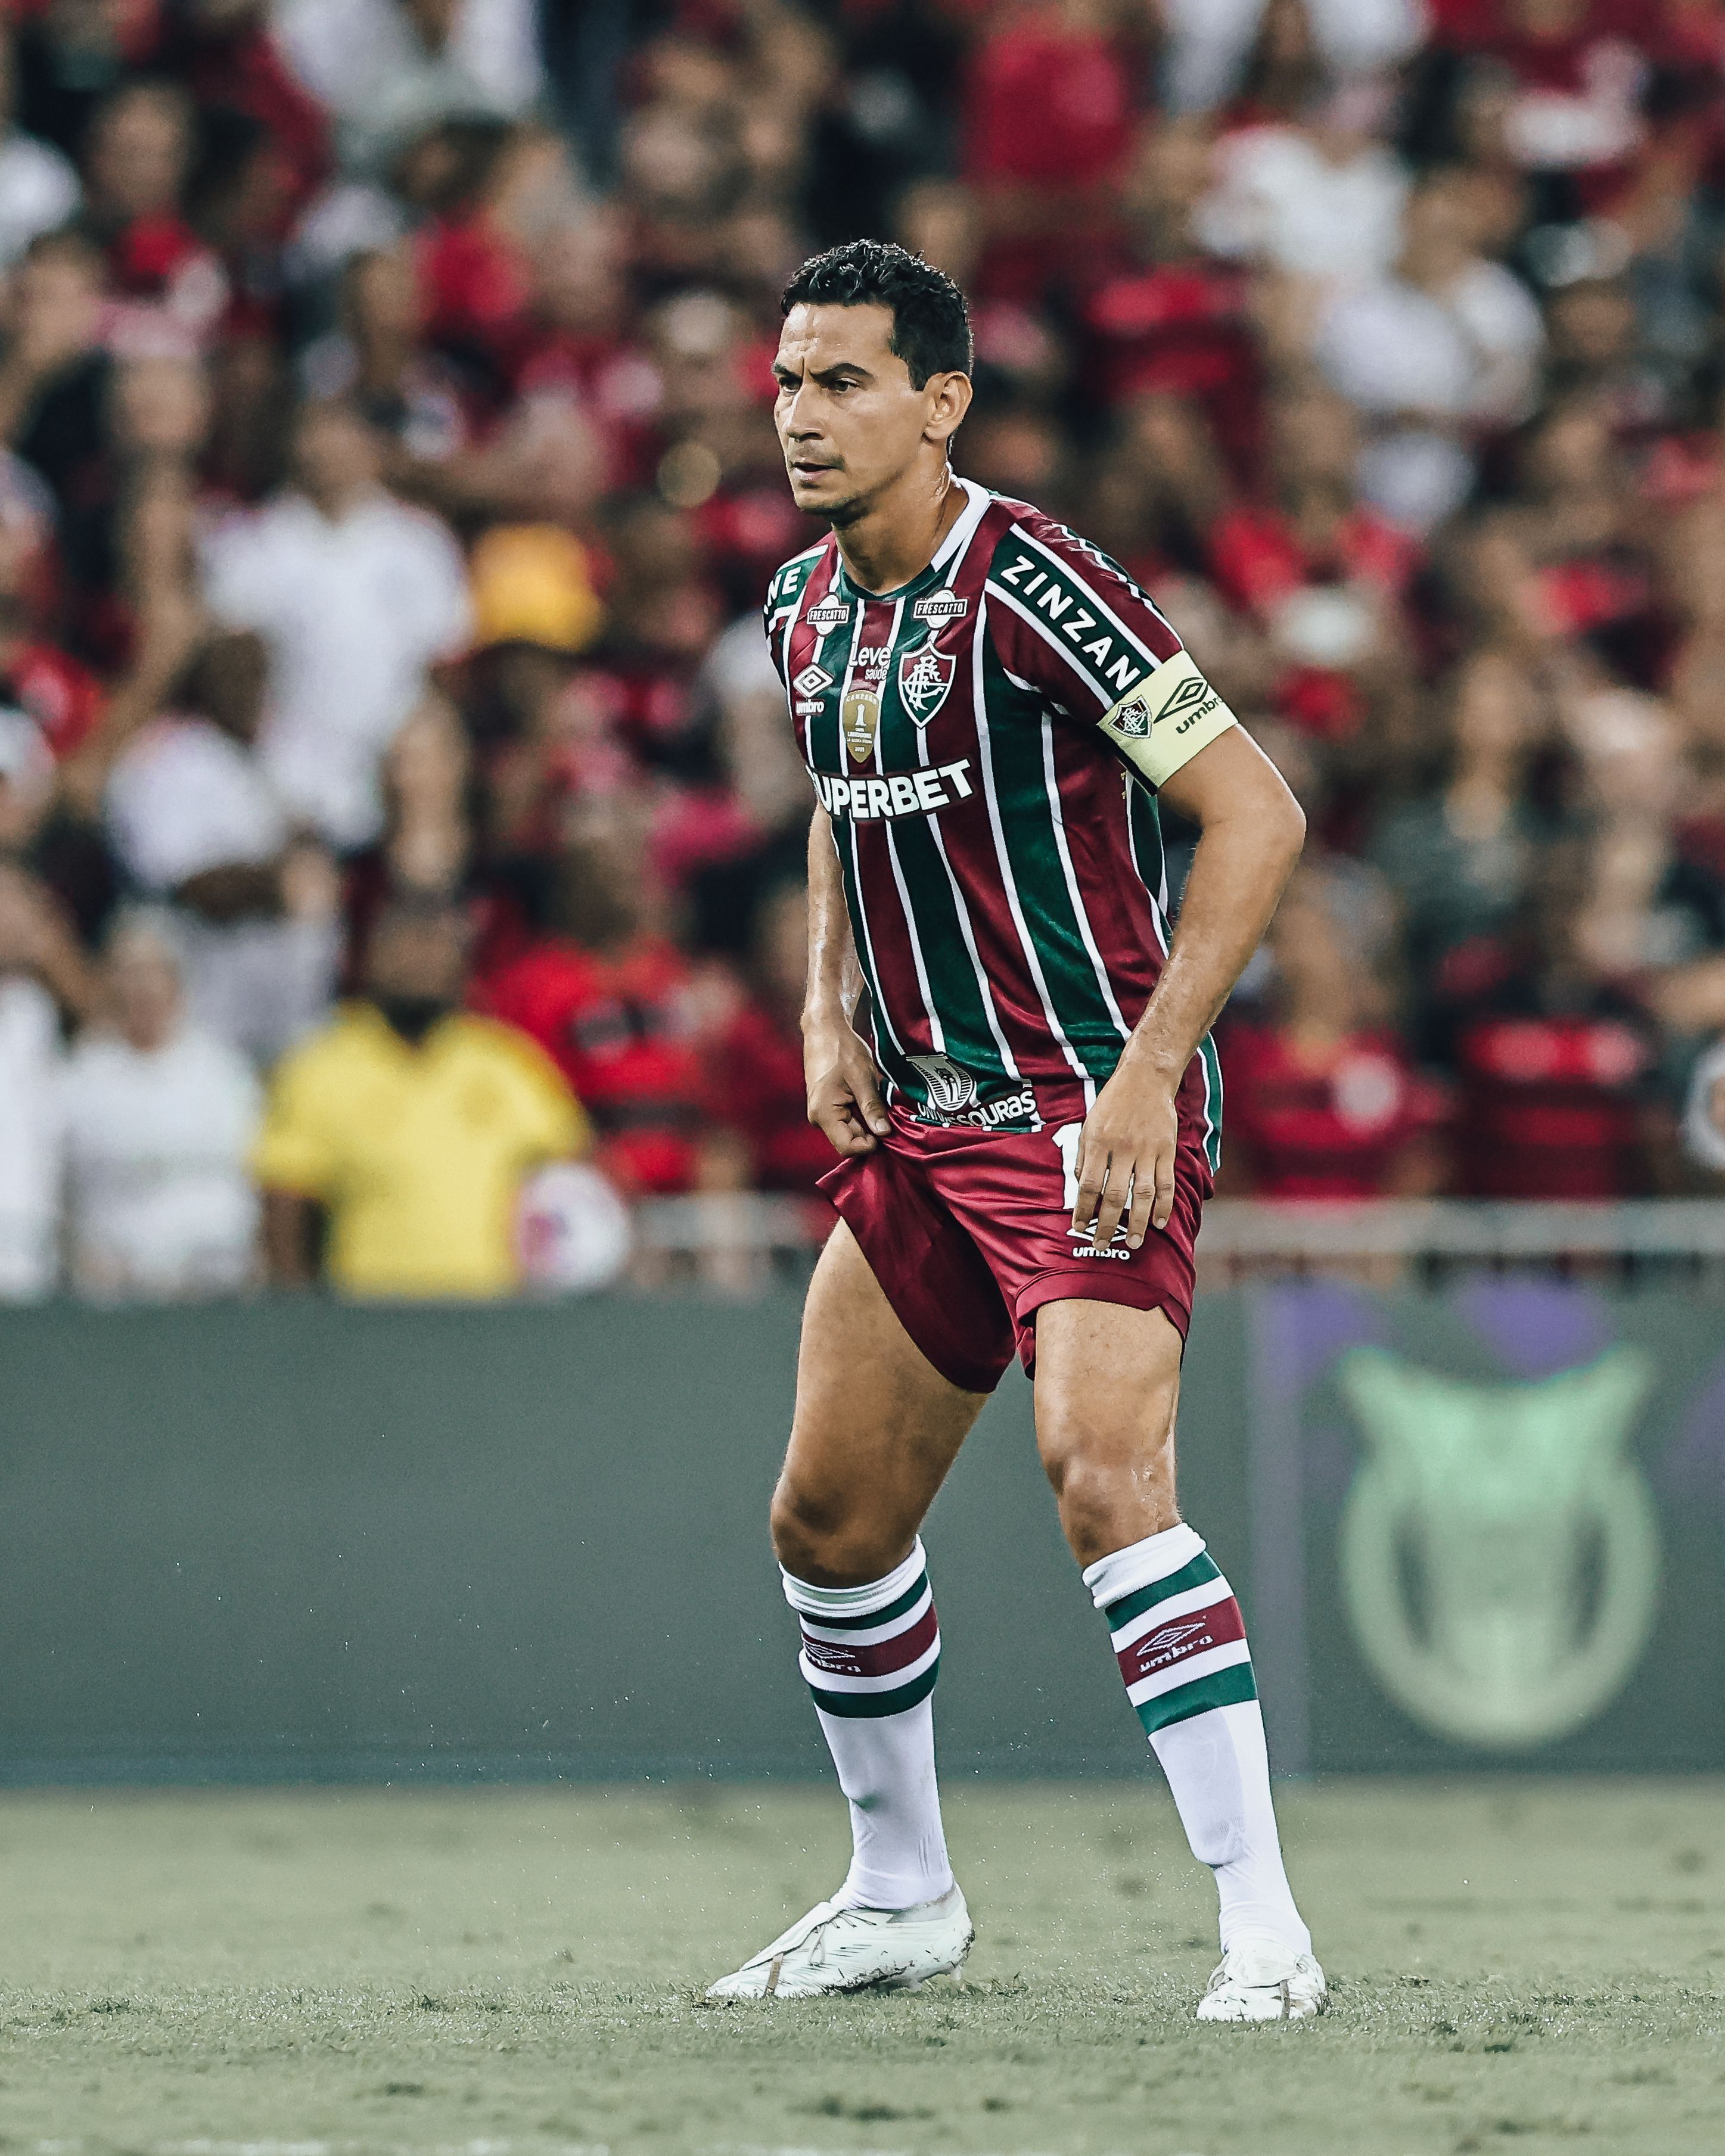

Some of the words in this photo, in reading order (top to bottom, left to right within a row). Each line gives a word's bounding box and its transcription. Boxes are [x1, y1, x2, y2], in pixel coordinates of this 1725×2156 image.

[809, 609, 846, 621] FRESCATTO
[917, 603, 963, 614] FRESCATTO
[848, 642, 891, 667] Leve
[865, 666, 888, 680] saúde
[795, 698, 825, 714] umbro
[805, 758, 973, 819] UPERBET
[1052, 1122, 1135, 1209] 1
[1072, 1246, 1130, 1260] umbro
[1140, 1635, 1214, 1673] umbro
